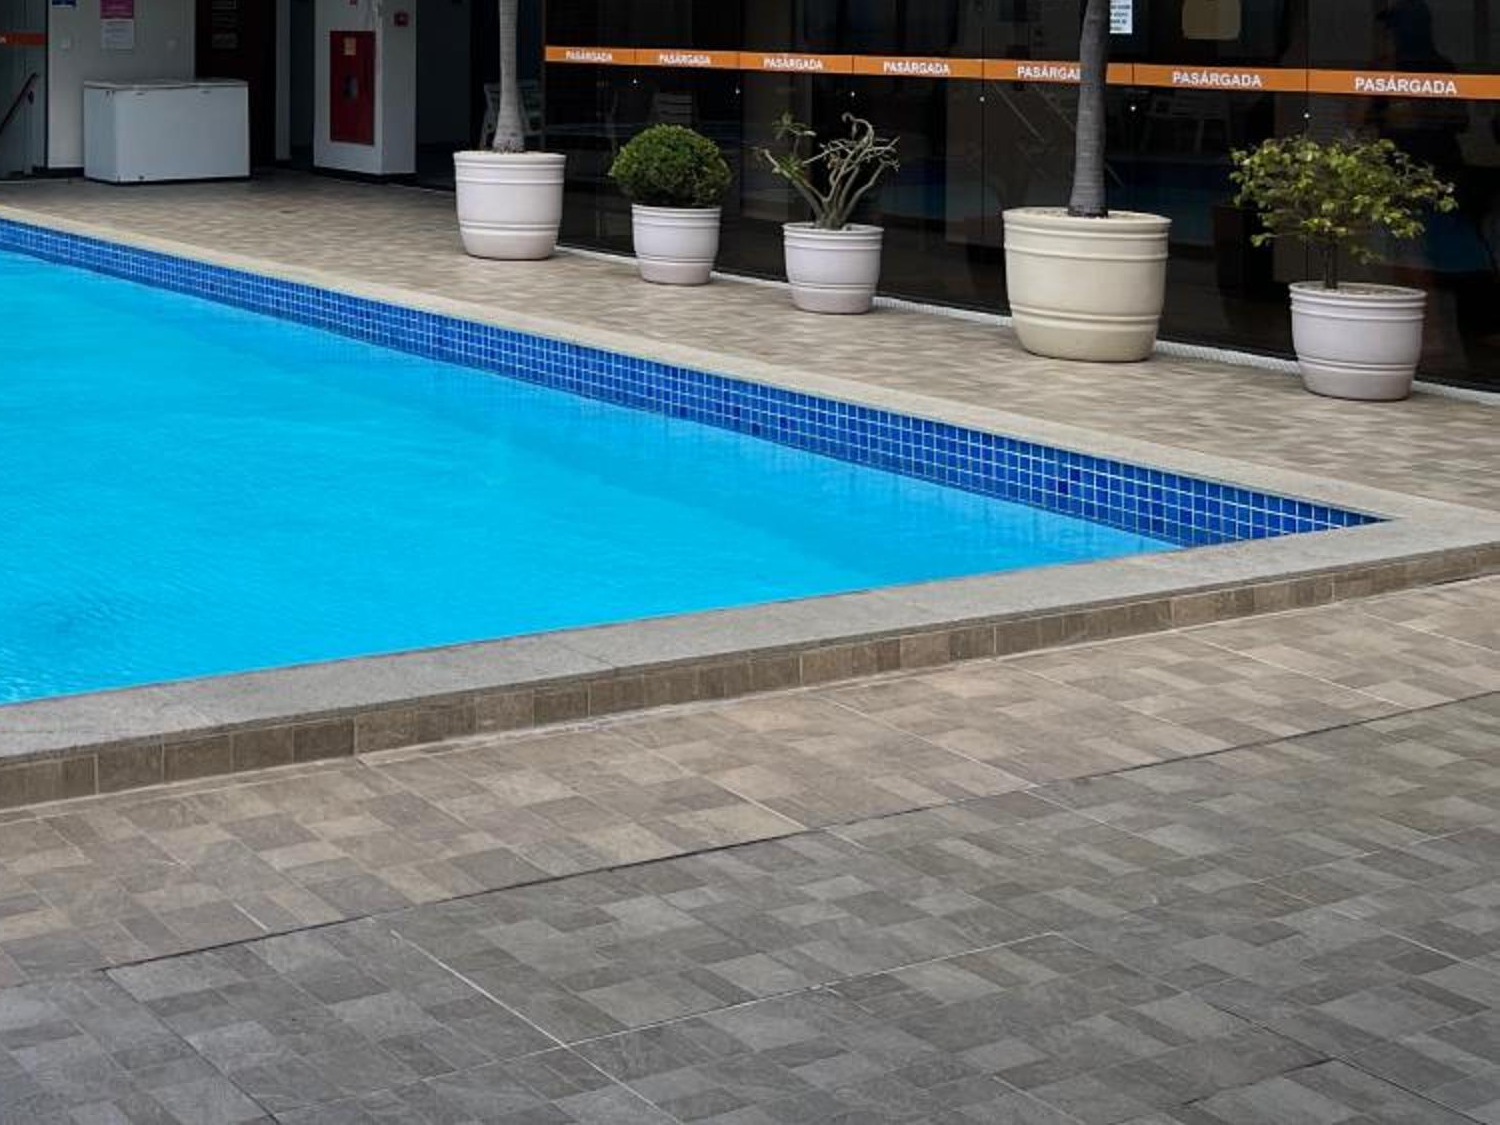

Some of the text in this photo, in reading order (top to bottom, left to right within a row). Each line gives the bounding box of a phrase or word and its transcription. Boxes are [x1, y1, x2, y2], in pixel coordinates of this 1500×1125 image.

[763, 55, 823, 70] PASÁRGADA
[883, 59, 951, 75] PASÁRGADA
[1017, 64, 1081, 80] PASÁRGA
[1172, 70, 1262, 88] PASÁRGADA
[1354, 76, 1457, 95] PASÁRGADA
